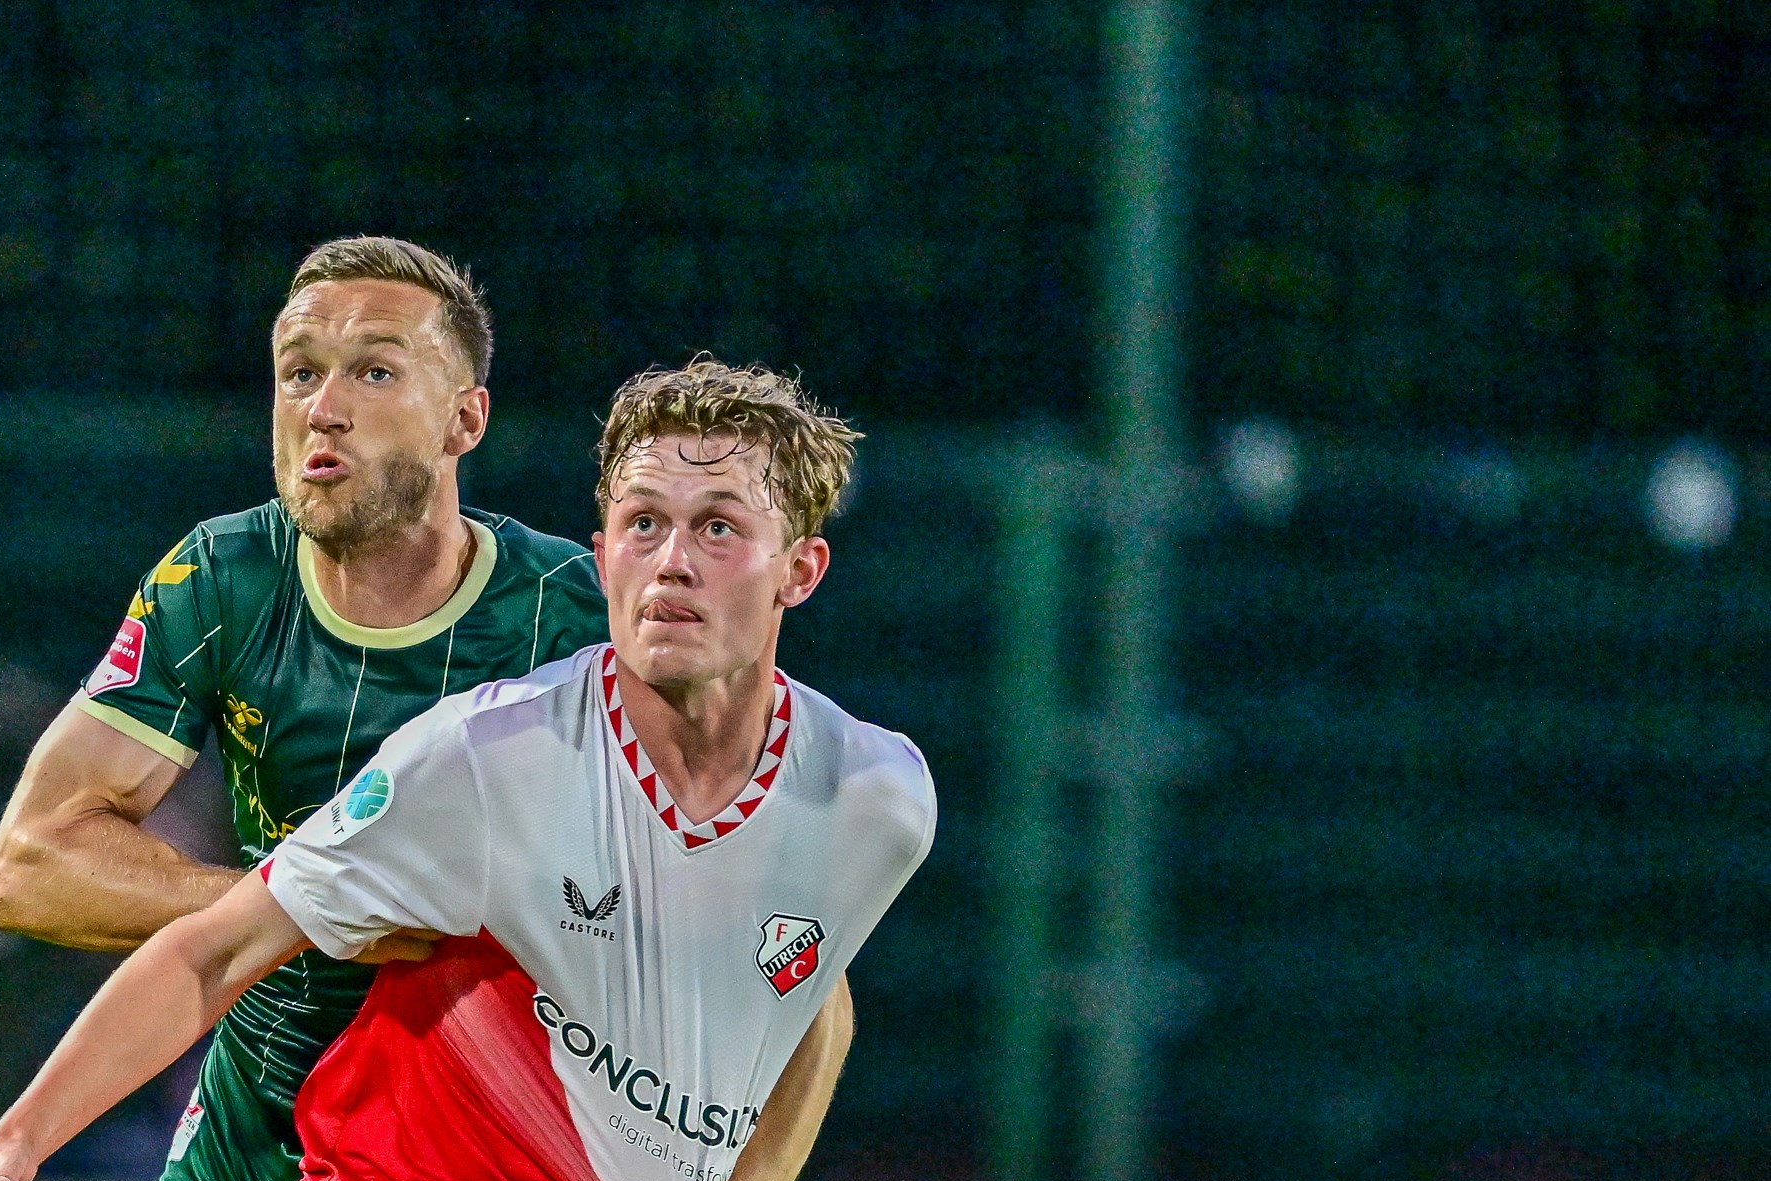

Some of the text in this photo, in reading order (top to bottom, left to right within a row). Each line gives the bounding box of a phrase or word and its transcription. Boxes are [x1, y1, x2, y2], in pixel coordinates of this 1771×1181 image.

[560, 920, 616, 942] CASTORE
[775, 922, 789, 942] F
[762, 925, 821, 978] UTRECHT
[790, 960, 807, 979] C
[532, 994, 759, 1150] CONCLUSI
[608, 1113, 670, 1162] digital
